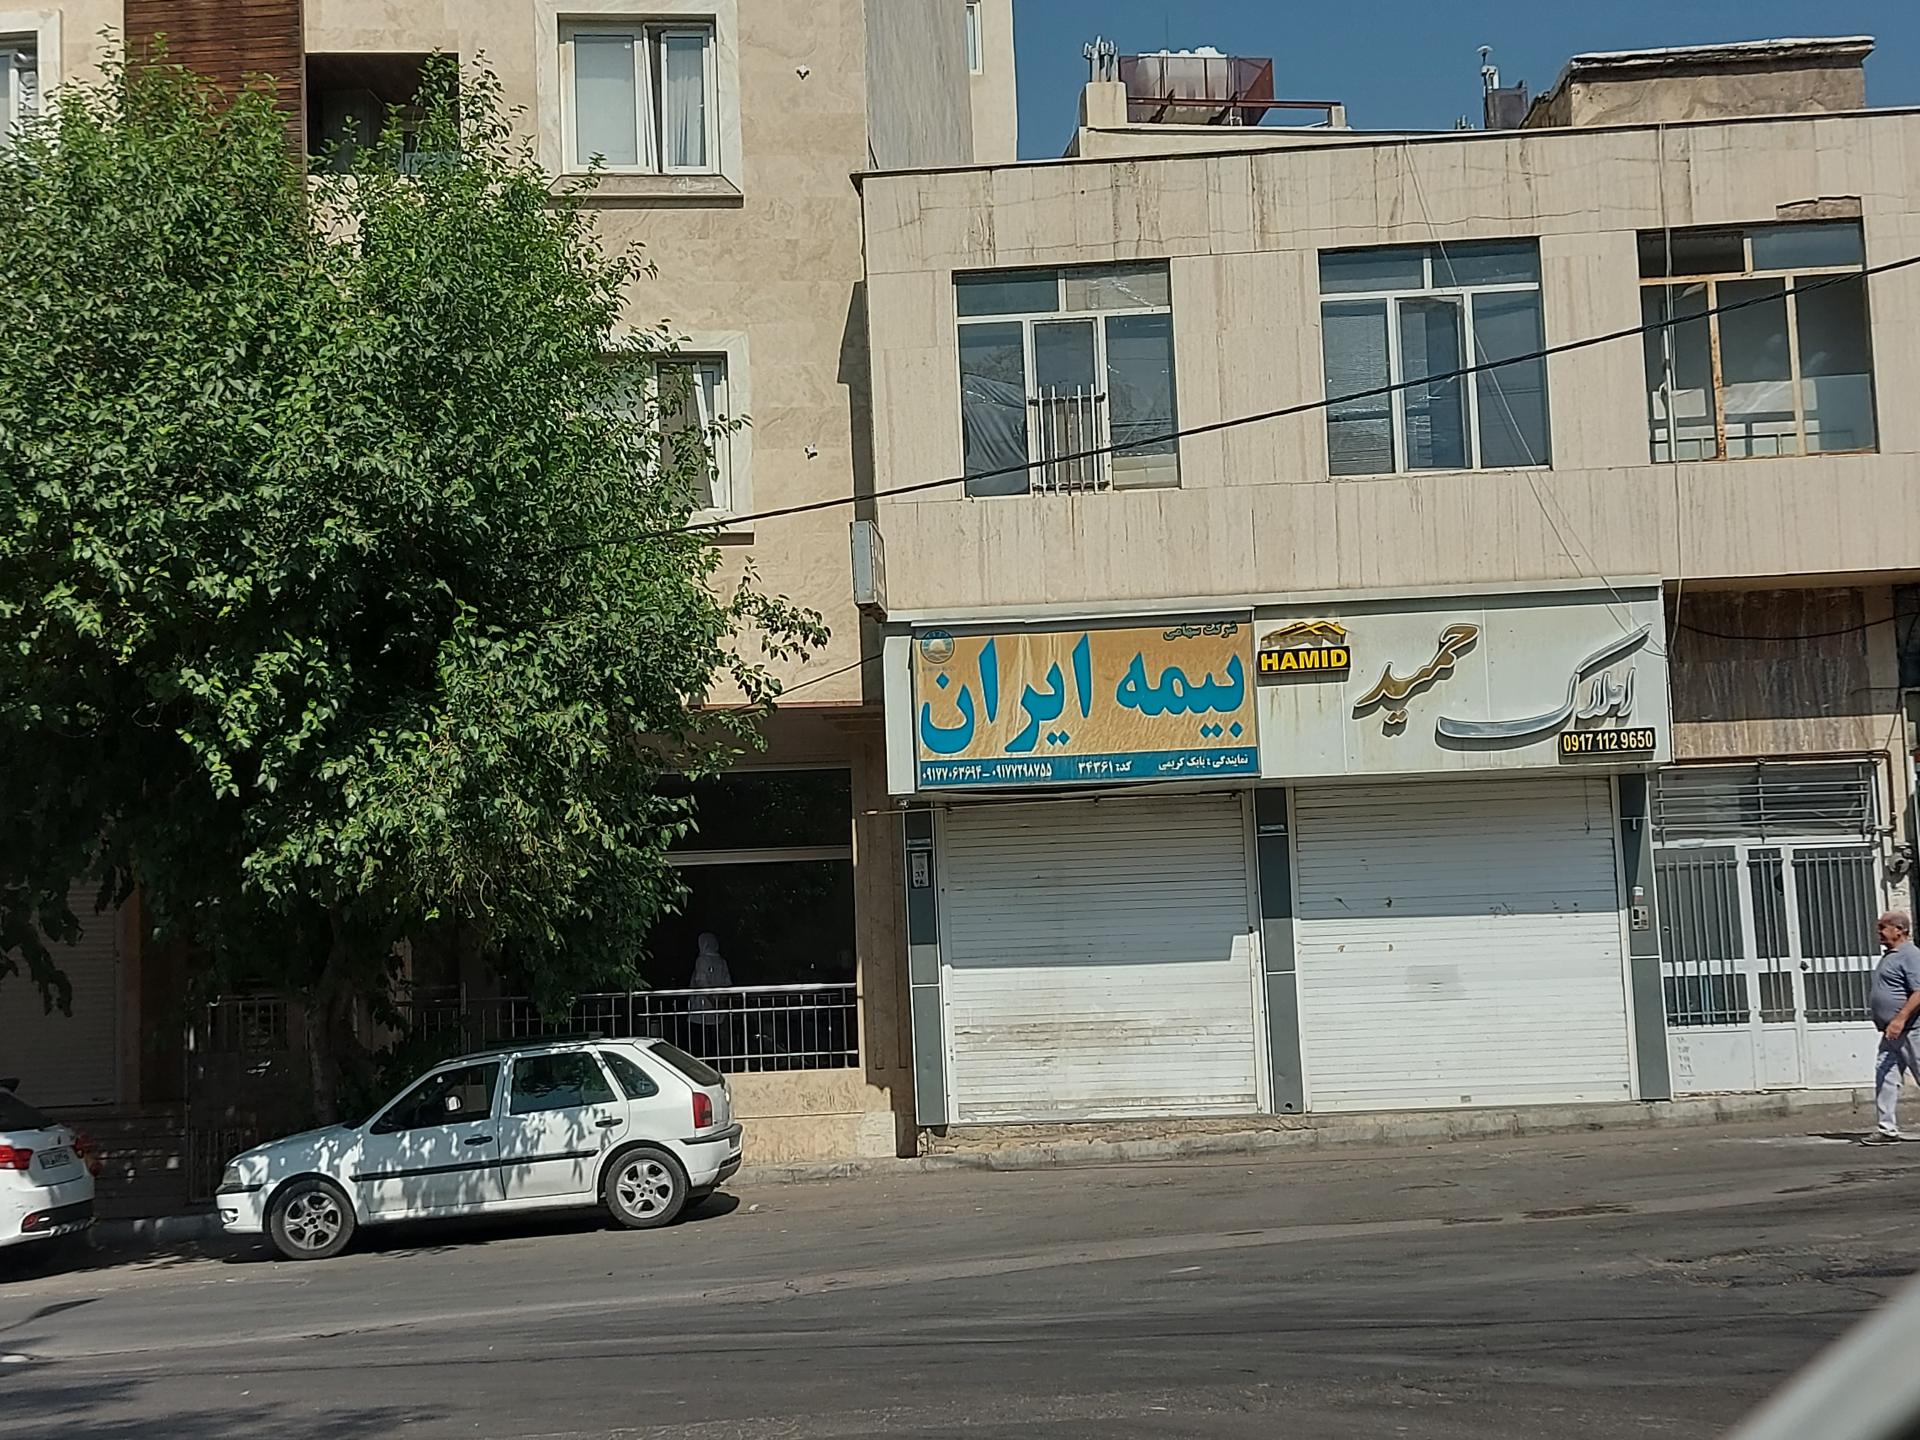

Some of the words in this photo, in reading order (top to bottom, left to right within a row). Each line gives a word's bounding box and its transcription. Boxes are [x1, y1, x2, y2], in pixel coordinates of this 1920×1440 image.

[1162, 622, 1201, 641] سهامی
[1202, 620, 1239, 639] شرکت
[1260, 648, 1348, 671] HAMID
[1352, 622, 1481, 725] حمید
[1436, 622, 1652, 739] املاک
[920, 631, 1093, 755] ایران
[1115, 651, 1246, 739] بیمه
[1563, 733, 1593, 752] 0917
[1596, 732, 1618, 750] 112
[1620, 730, 1653, 749] 9650
